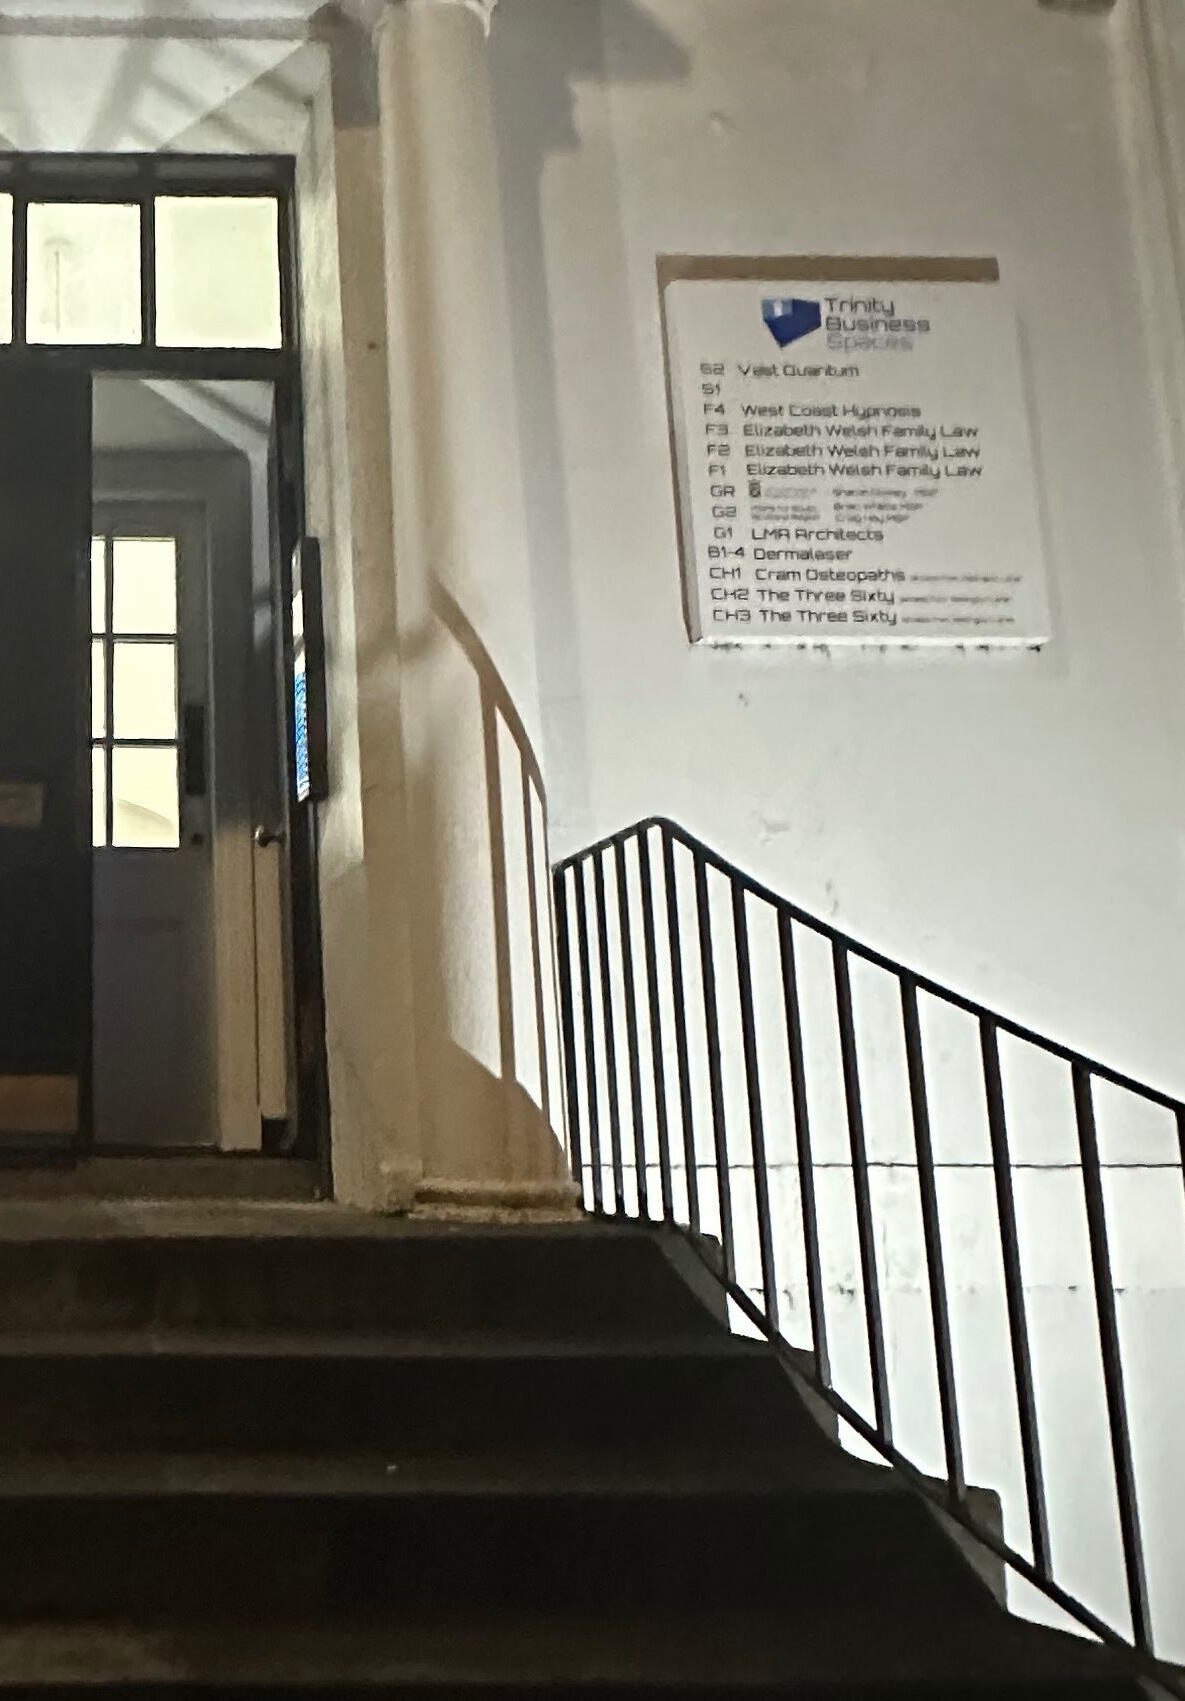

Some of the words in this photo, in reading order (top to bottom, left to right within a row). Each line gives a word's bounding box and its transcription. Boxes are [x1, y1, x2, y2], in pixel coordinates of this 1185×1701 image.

[824, 297, 895, 317] Trinity
[825, 316, 931, 332] Business
[825, 333, 914, 352] Spaces
[737, 362, 778, 376] Vast
[782, 362, 860, 377] Quantum
[703, 403, 724, 415] F4
[741, 403, 784, 417] West
[788, 403, 838, 417] Coast
[843, 403, 921, 420] Hypnosis
[705, 423, 728, 436] F3
[743, 423, 821, 437] Elizabeth
[825, 424, 877, 437] Welsh
[881, 424, 936, 440] Family
[939, 425, 979, 438] Law
[707, 443, 730, 456] F2
[745, 443, 823, 457] Elizabeth
[827, 444, 880, 458] Welsh
[884, 445, 938, 460] Family
[942, 446, 981, 459] Law
[708, 464, 725, 476] F1
[746, 463, 825, 476] Elizabeth
[829, 463, 882, 477] Welsh
[885, 464, 940, 480] Family
[944, 465, 983, 478] Law
[712, 505, 737, 518] G2
[714, 526, 733, 540] G1
[751, 528, 790, 541] LMA
[794, 527, 884, 542] Architects
[708, 545, 745, 558] B1-4
[753, 547, 853, 561] Dermalaser
[709, 566, 741, 580] CH1
[755, 568, 802, 582] Cram
[805, 568, 906, 584] Osteopaths
[710, 587, 749, 601] CH2
[756, 588, 790, 603] The
[794, 588, 846, 603] Three
[850, 588, 895, 605] Sixty
[712, 608, 751, 623] CH3
[758, 609, 792, 624] The
[796, 609, 848, 624] Three
[852, 608, 897, 626] Sixty
